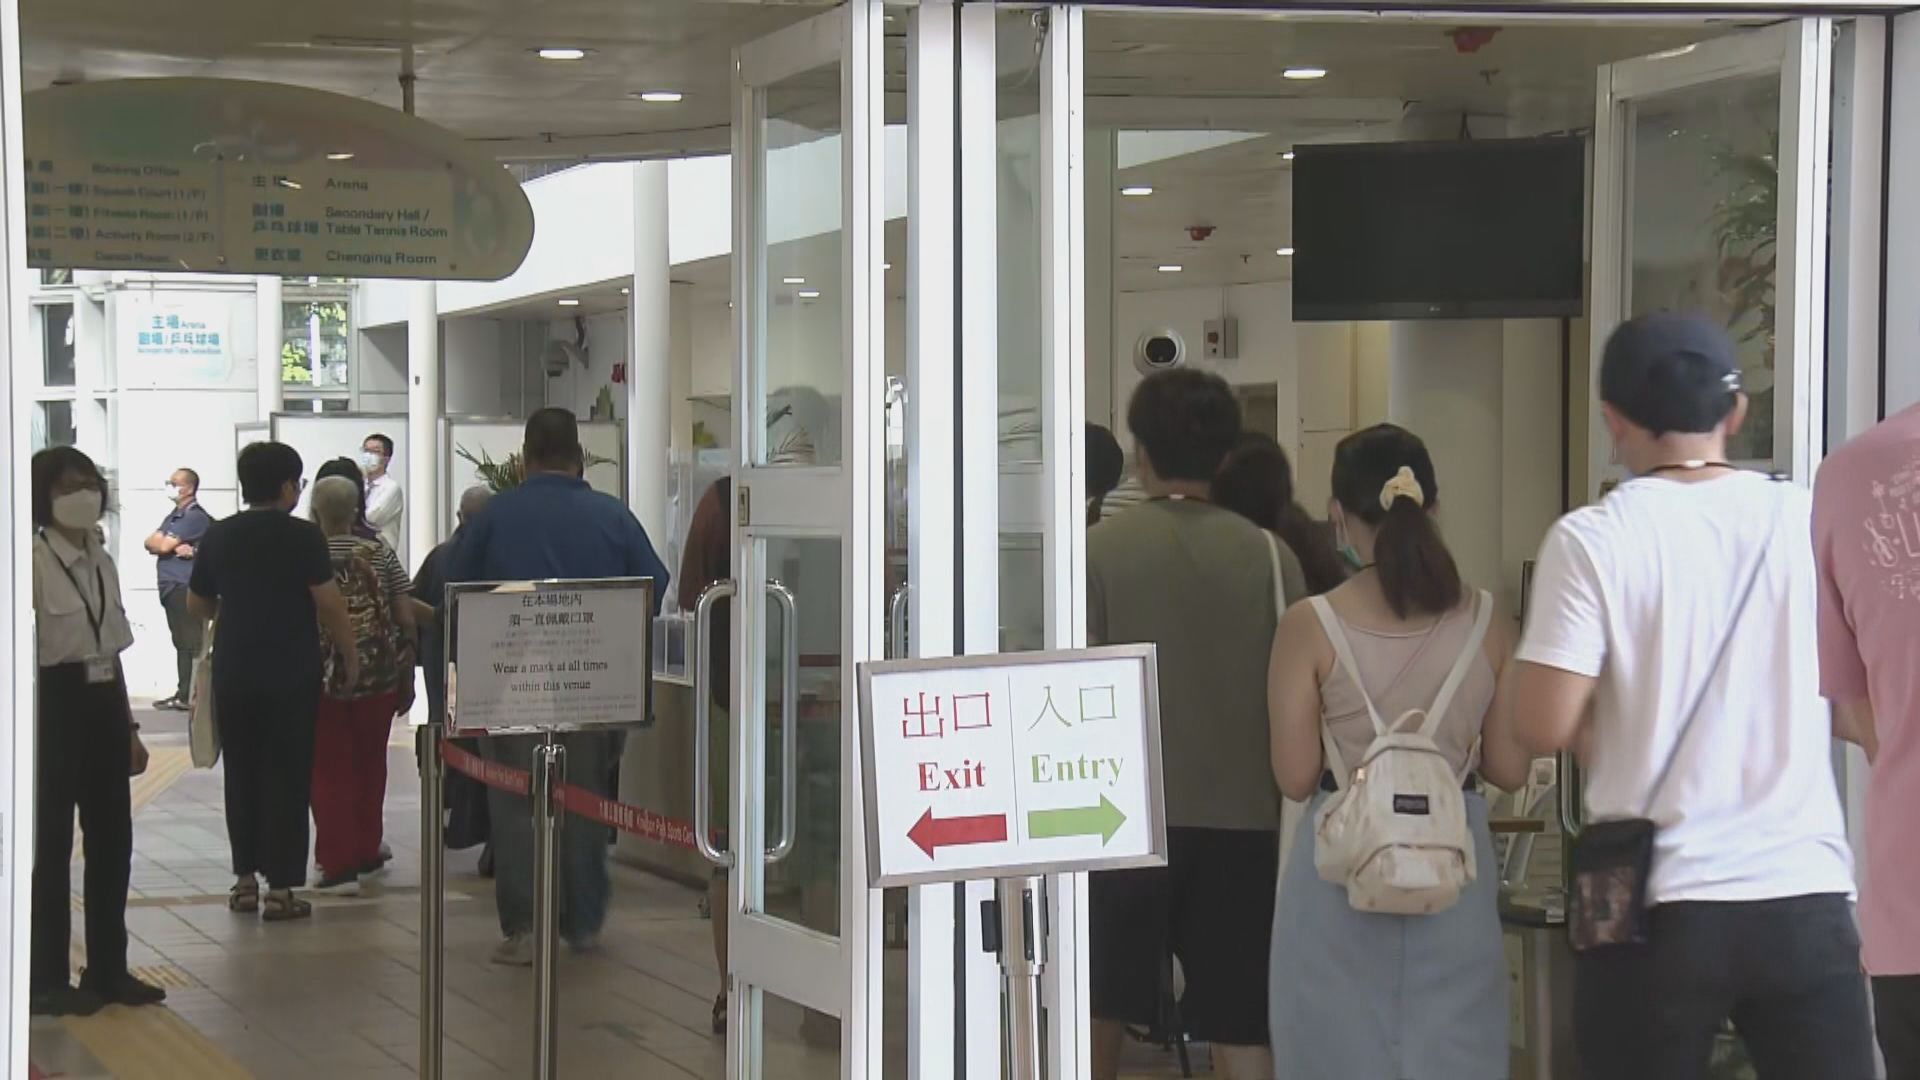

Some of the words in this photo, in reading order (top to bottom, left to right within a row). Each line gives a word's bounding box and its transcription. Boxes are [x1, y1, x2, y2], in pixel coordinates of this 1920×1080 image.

[326, 178, 369, 190] Arena
[325, 206, 394, 221] Secondary
[396, 208, 421, 221] Hall
[326, 223, 361, 236] Table
[365, 224, 407, 236] Tennis
[409, 225, 448, 238] Room
[326, 250, 392, 264] Changing
[394, 252, 437, 264] Room
[493, 662, 518, 674] Wear
[557, 662, 566, 672] at
[568, 660, 580, 671] all
[583, 660, 608, 671] times
[511, 681, 540, 692] within
[543, 680, 560, 691] this
[563, 680, 591, 690] venue
[902, 691, 992, 739] 出口
[1027, 684, 1118, 732] 入口
[918, 759, 987, 792] Exit
[1031, 753, 1124, 787] Entry
